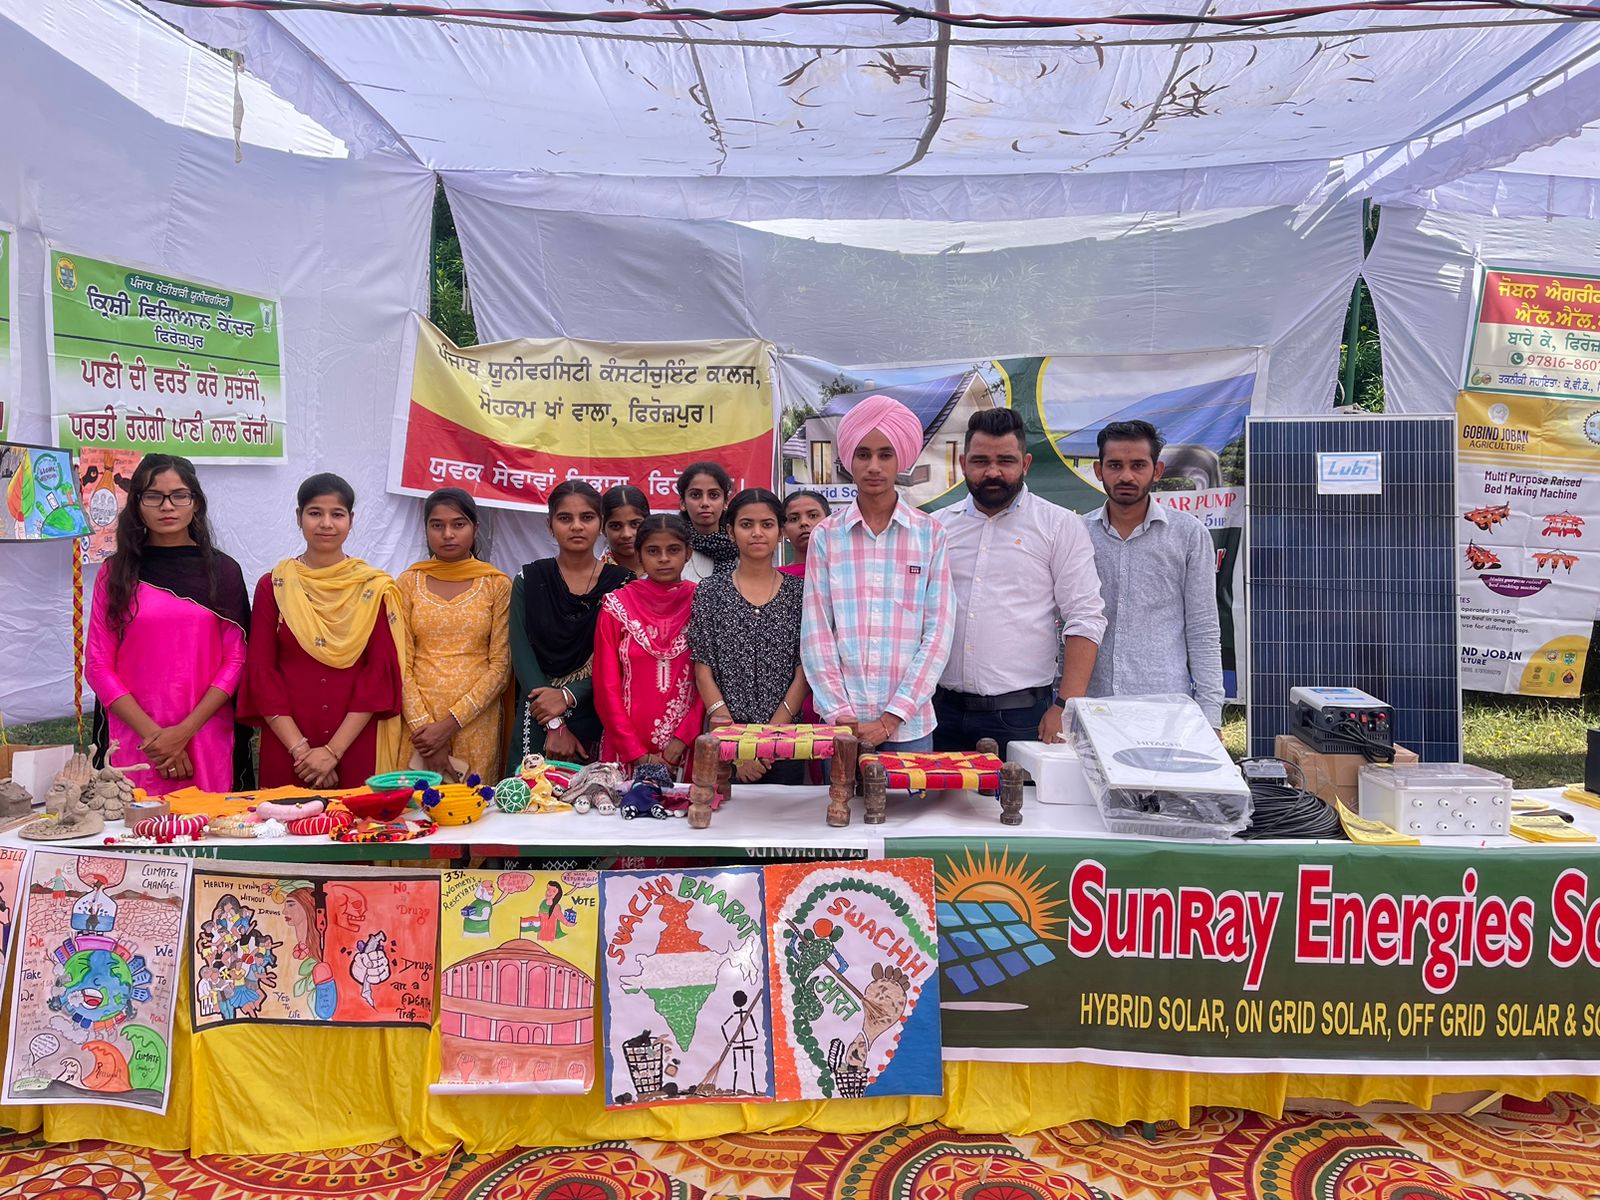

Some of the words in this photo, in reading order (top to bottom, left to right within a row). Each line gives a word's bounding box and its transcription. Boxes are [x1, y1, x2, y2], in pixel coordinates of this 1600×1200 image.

[130, 276, 153, 290] ਪੰਜਾਬ
[155, 280, 189, 298] ਖੇਤੀਬਾੜੀ
[190, 288, 230, 307] ਯੂਨੀਵਰਸਿਟੀ
[1498, 275, 1540, 299] ਜੋਬਨ
[138, 296, 211, 329] ਵਿਗਿਆਨ
[216, 311, 255, 337] ਕੇਂਦਰ
[154, 326, 204, 349] ਫਿਰੋਜ਼ਪੁਰ
[1507, 328, 1534, 347] ਬਾਰੇ
[437, 342, 480, 377] ਪੰਜਾਬ
[488, 356, 593, 388] ਯੂਨੀਵਰਸਿਟੀ
[599, 357, 699, 389] ਕੰਸਟੀਚੁਇੰਟ
[706, 365, 761, 390] ਕਾਲਜ,
[81, 353, 123, 389] ਪਾਣੀ
[128, 357, 146, 391] ਦੀ
[153, 359, 190, 394] ਵਰਤੋਂ
[197, 363, 218, 398] ਕਰੋ
[1498, 372, 1527, 385] ਤਕਨੀਕੀ
[479, 387, 536, 419] ਮੋਹਕਮ
[544, 396, 564, 420] ਖਾਂ
[572, 404, 617, 427] ਵਾਲਾ,
[68, 404, 117, 441] ਧਰਤੀ
[126, 406, 166, 442] ਰਹੇਗੀ
[172, 410, 203, 442] ਪਾਣੀ
[210, 420, 237, 443] ਨਾਲ
[1463, 425, 1499, 440] GOBIND
[1500, 428, 1529, 443] JOBAN
[1469, 440, 1526, 452] AGRICULTURE
[429, 457, 484, 483] ਯੁਵਕ
[492, 460, 557, 492] ਸੇਵਾਵਾਂ
[1328, 461, 1370, 476] Lubi
[1484, 471, 1507, 482] Multi
[1509, 472, 1549, 486] Purpose
[1550, 476, 1582, 488] Raised
[1484, 483, 1502, 494] Bed
[1504, 485, 1538, 499] Making
[1540, 488, 1578, 500] Machine
[1195, 493, 1237, 510] PUMP
[1481, 649, 1522, 661] JOBAN
[1136, 740, 1182, 749] HITACHI
[142, 864, 179, 877] CLIMATE
[444, 871, 466, 883] 33%
[203, 879, 234, 890] HEALTHY
[241, 893, 265, 903] WITHOUT
[571, 896, 596, 907] VOTE
[608, 876, 673, 965] SWACHH
[677, 875, 762, 940] BHARAT
[827, 896, 928, 979] SWACHH
[1295, 863, 1535, 995] Energies
[29, 934, 44, 947] We
[154, 945, 173, 957] We
[21, 969, 42, 981] Take
[399, 957, 432, 981] Drugs
[156, 975, 167, 985] To
[412, 982, 420, 990] a
[21, 990, 35, 1002] We
[273, 991, 290, 1002] Yes
[288, 1009, 300, 1018] Life
[1080, 992, 1153, 1029] HYBRID
[1158, 996, 1230, 1039] SOLAR,
[1235, 999, 1263, 1033] ON
[1268, 999, 1316, 1035] GRID
[1321, 1001, 1392, 1042] SOLAR,
[1397, 1002, 1435, 1037] OFF
[1440, 1002, 1486, 1037] GRID
[1496, 1003, 1559, 1037] SOLAR
[1564, 1003, 1577, 1037] &
